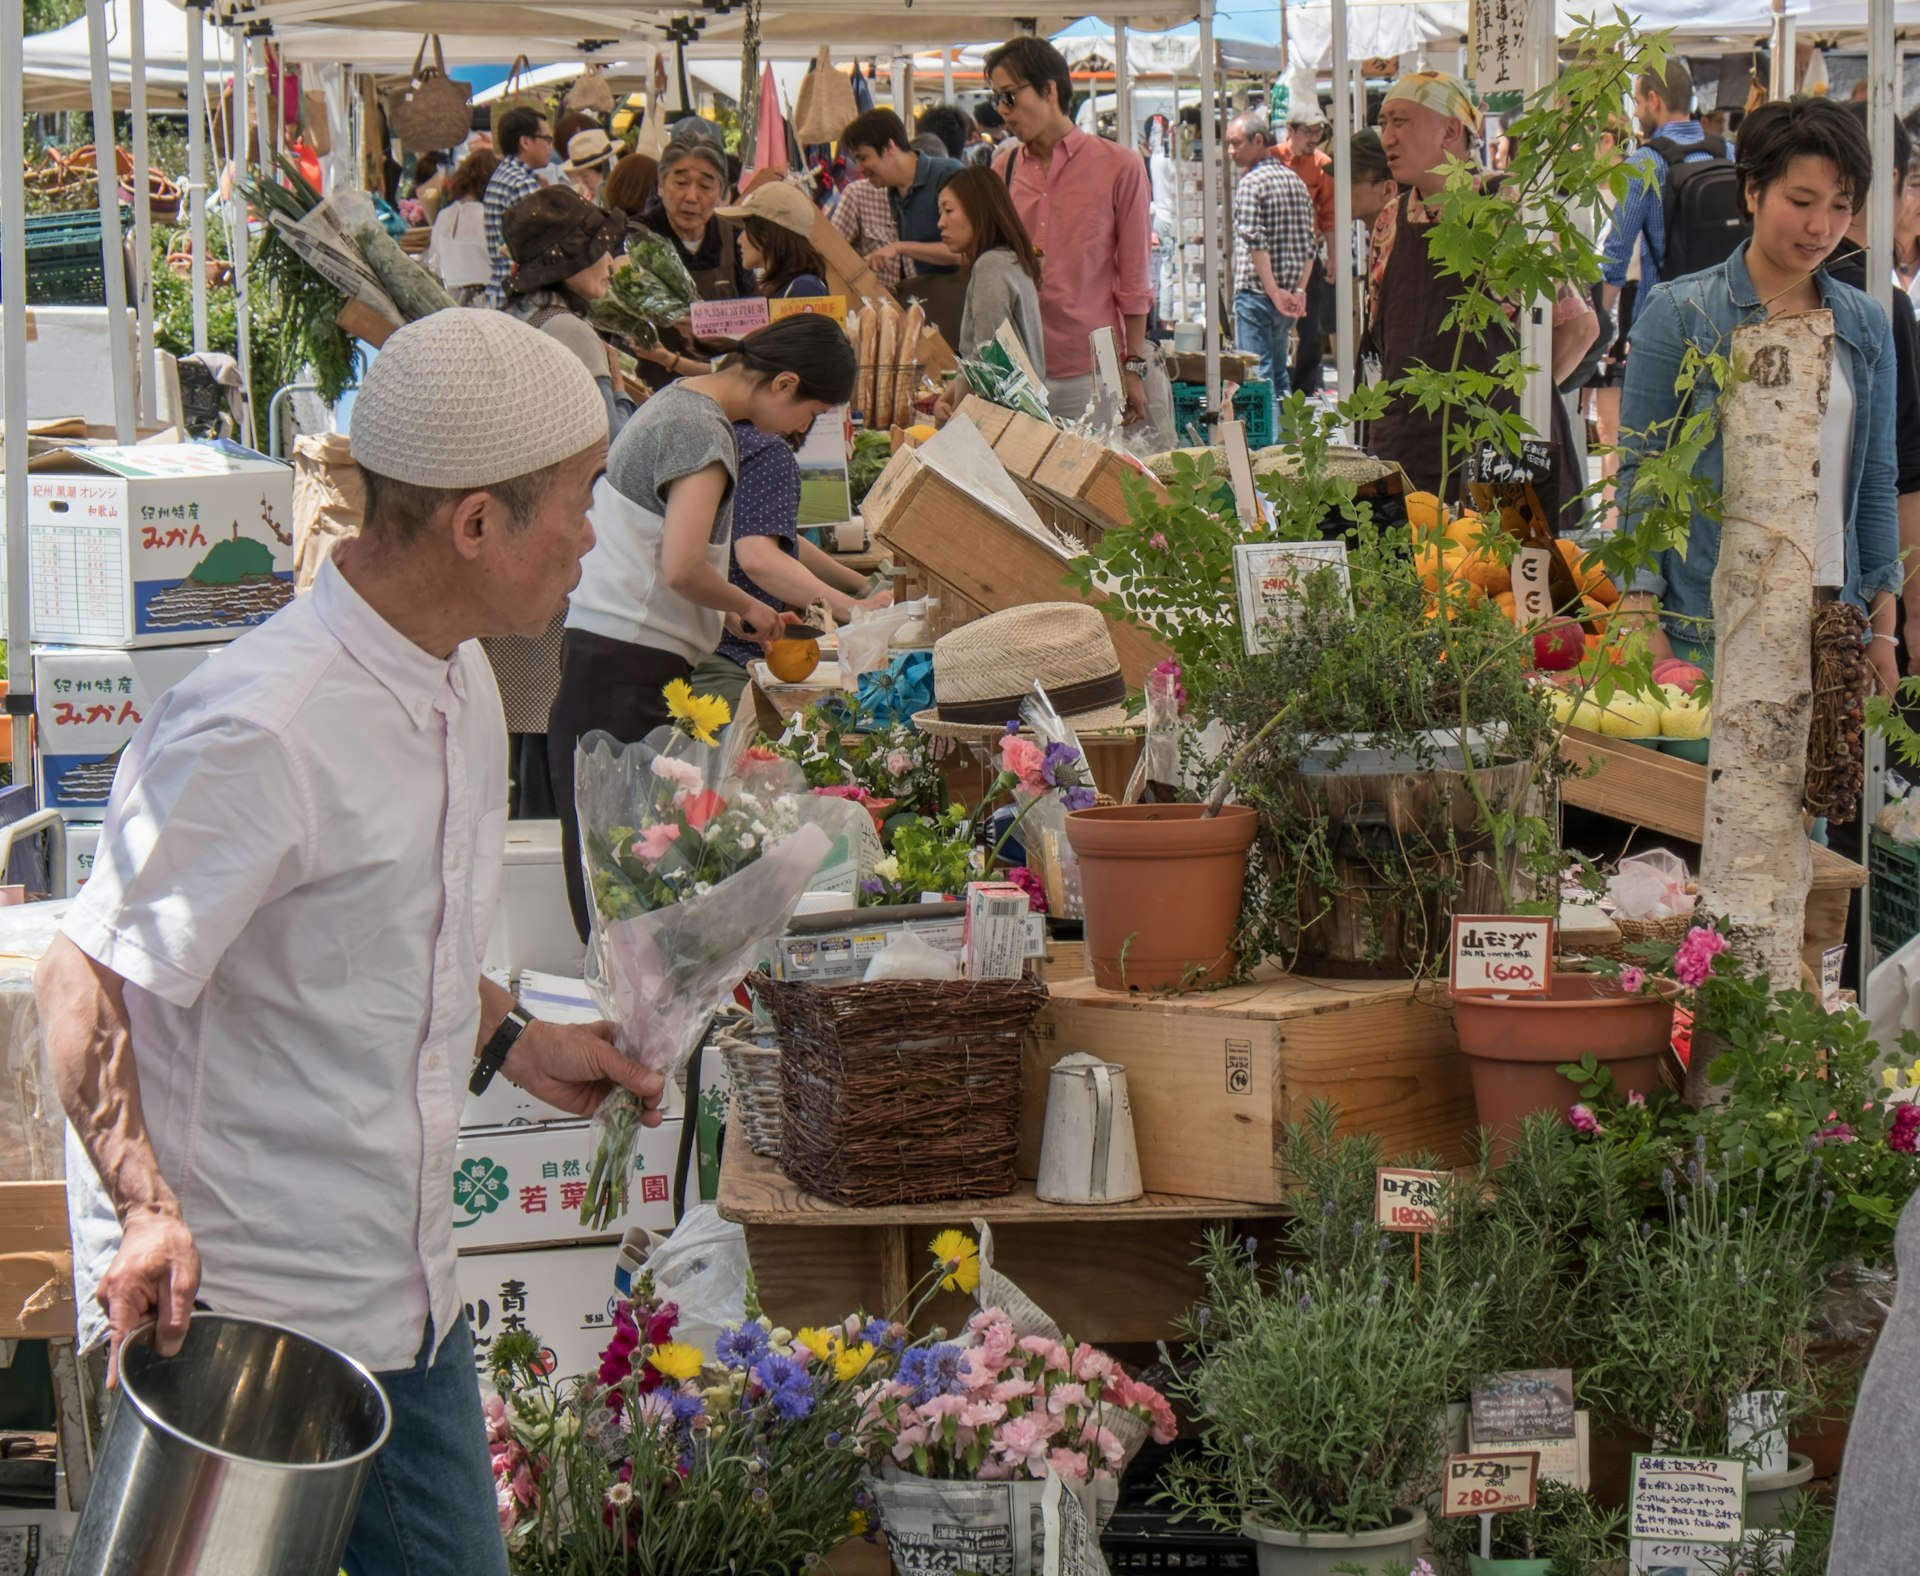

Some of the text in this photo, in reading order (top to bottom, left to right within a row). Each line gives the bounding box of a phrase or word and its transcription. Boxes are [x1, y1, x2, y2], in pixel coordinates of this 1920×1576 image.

[33, 485, 117, 499] 紀州 黒潮 オレンジ
[88, 505, 118, 517] 和歌山
[141, 502, 199, 520] 紀州特産
[141, 523, 207, 549] みかん
[53, 676, 132, 694] 紀州特産
[53, 700, 143, 725] みかん
[519, 1174, 670, 1214] 若葉園
[1457, 1489, 1521, 1506] 280 yen
